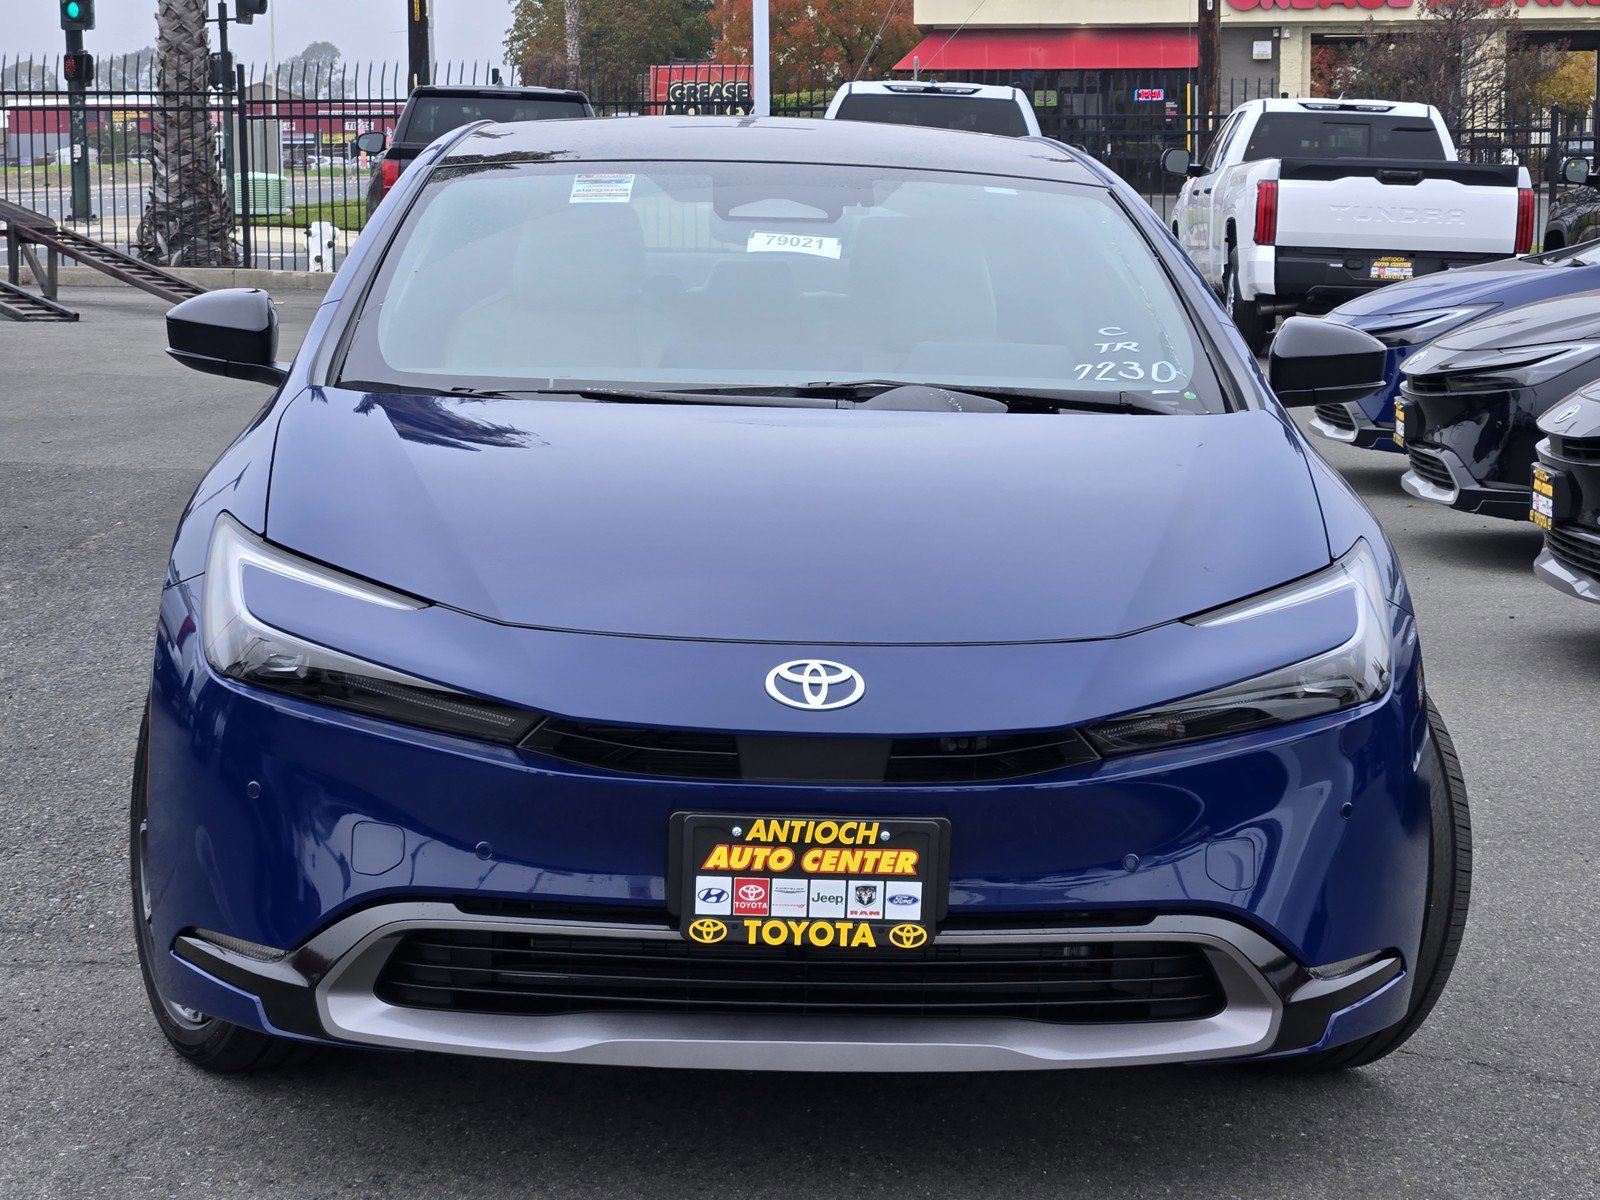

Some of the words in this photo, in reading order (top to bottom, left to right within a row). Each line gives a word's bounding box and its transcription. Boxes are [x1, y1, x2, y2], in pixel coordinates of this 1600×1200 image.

[669, 82, 752, 102] GREASE
[1329, 204, 1466, 225] TUNDRA
[765, 234, 824, 249] 79021
[1097, 326, 1129, 336] C
[1094, 341, 1140, 354] TR
[745, 819, 880, 845] ANTIOCH
[701, 844, 796, 872] AUTO
[801, 847, 919, 876] CENTER
[734, 901, 768, 909] TOYOTA
[811, 892, 844, 905] Jeep
[891, 894, 914, 905] Ford
[744, 919, 877, 947] TOYOTA
